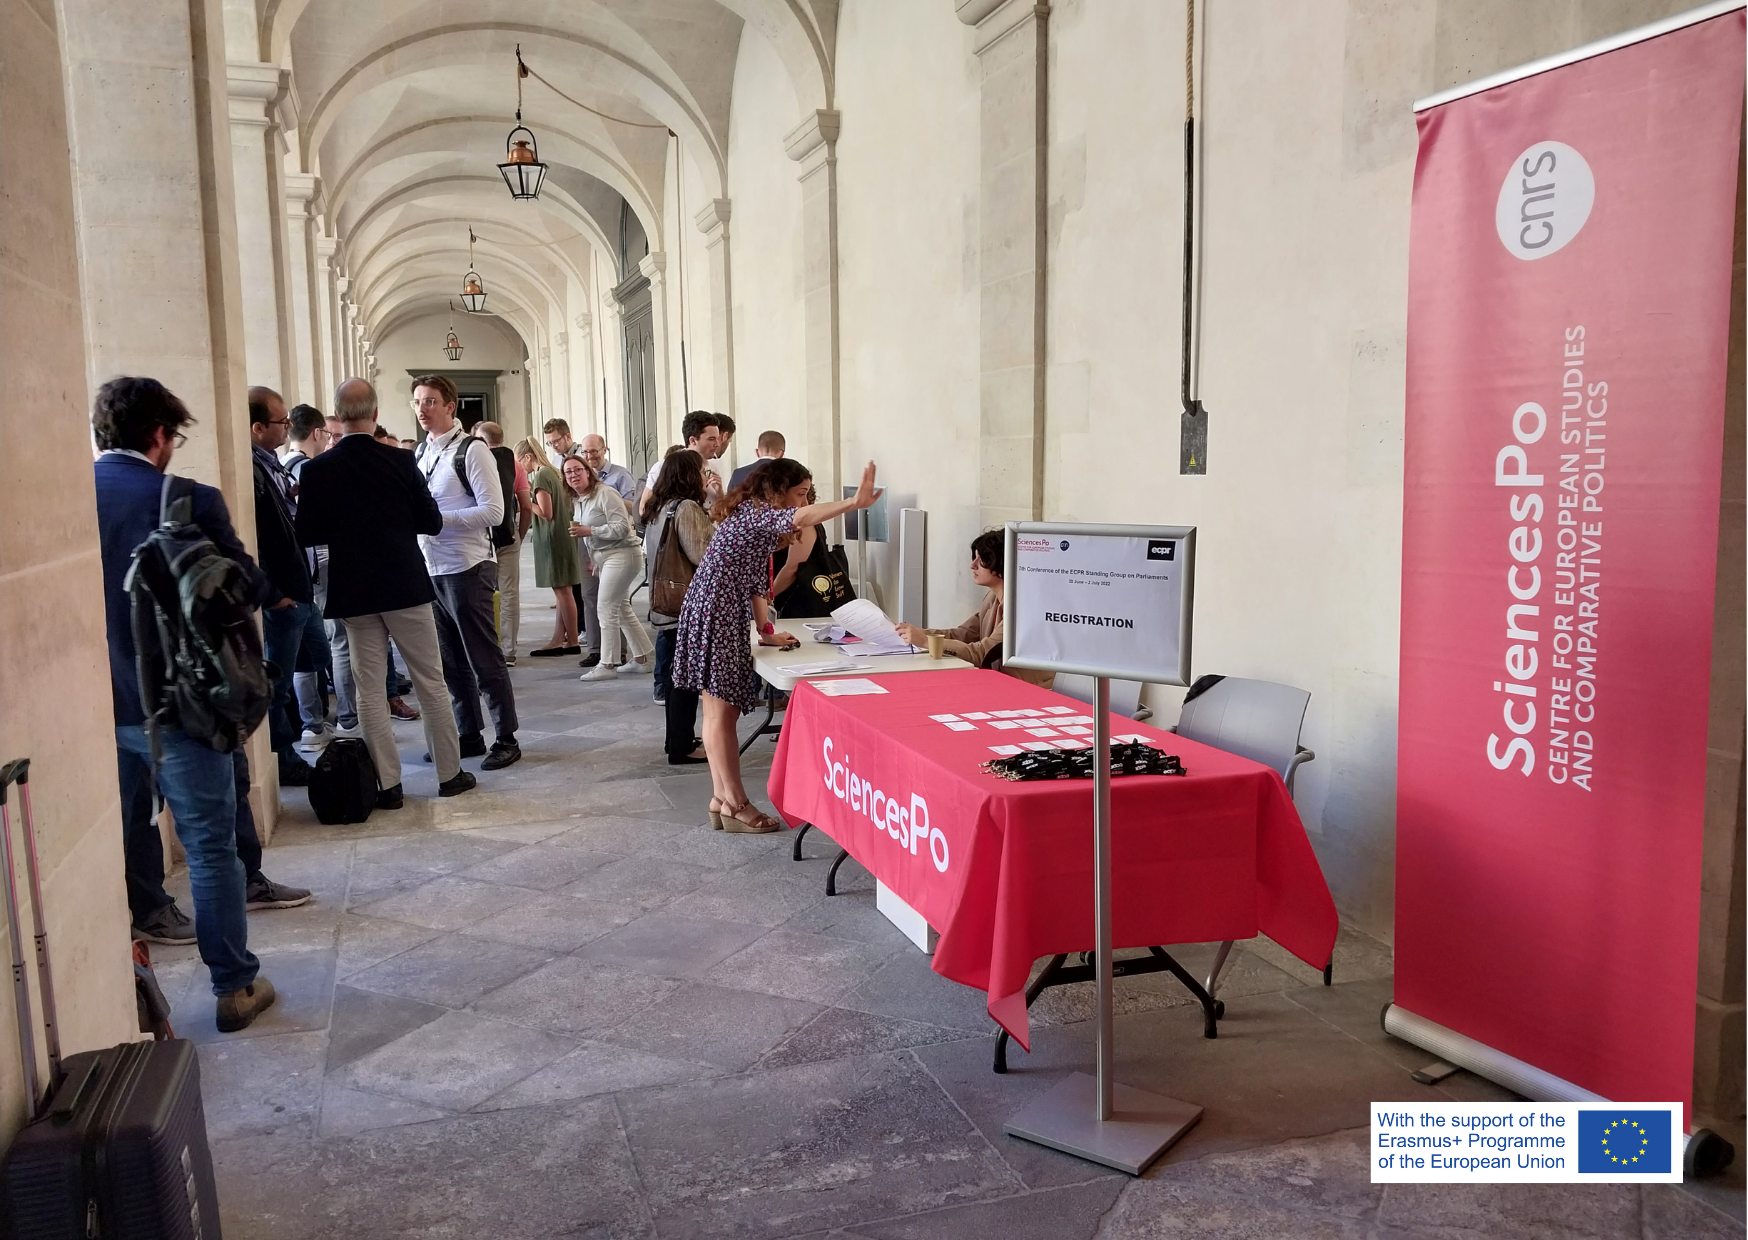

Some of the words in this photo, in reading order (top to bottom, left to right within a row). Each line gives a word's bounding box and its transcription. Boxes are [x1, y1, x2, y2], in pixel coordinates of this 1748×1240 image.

[1520, 151, 1556, 249] cnrs
[1561, 324, 1586, 445] STUDIES
[1583, 380, 1608, 512] POLITICS
[1151, 546, 1171, 555] ecpr
[1556, 454, 1579, 605] EUROPEAN
[1045, 612, 1133, 629] REGISTRATION
[1487, 402, 1547, 777] SciencesPo
[1553, 616, 1573, 669] FOR
[1575, 522, 1602, 723] COMPARATIVE
[1548, 678, 1571, 785] CENTRE
[1573, 731, 1594, 792] AND
[824, 736, 949, 872] SciencesPo
